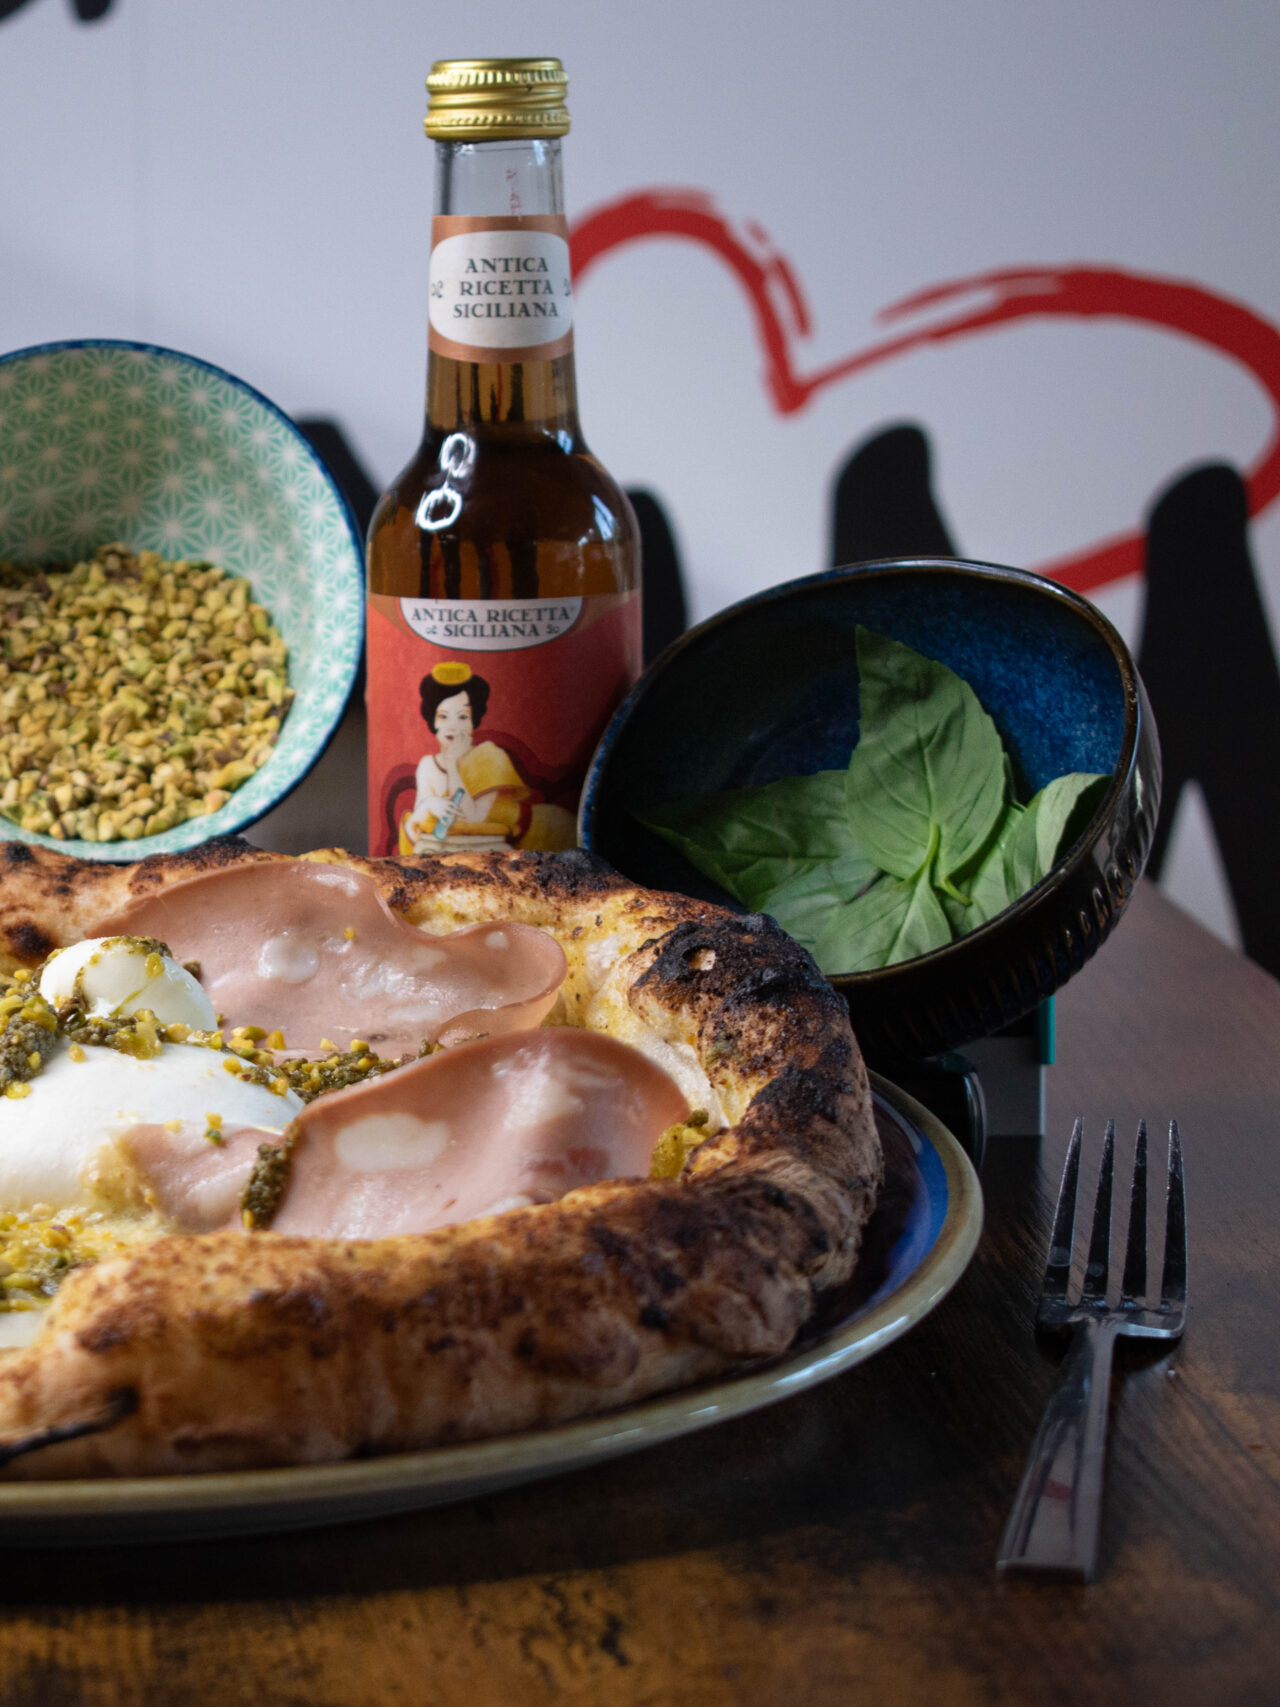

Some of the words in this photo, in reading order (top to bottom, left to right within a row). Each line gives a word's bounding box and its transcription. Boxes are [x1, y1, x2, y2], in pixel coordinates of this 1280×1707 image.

[464, 257, 549, 274] ANTICA
[459, 279, 554, 296] RICETTA
[452, 301, 559, 319] SICILIANA
[411, 606, 478, 622] ANTICA
[486, 606, 570, 622] RICETTA
[443, 622, 540, 638] SICILIANA
